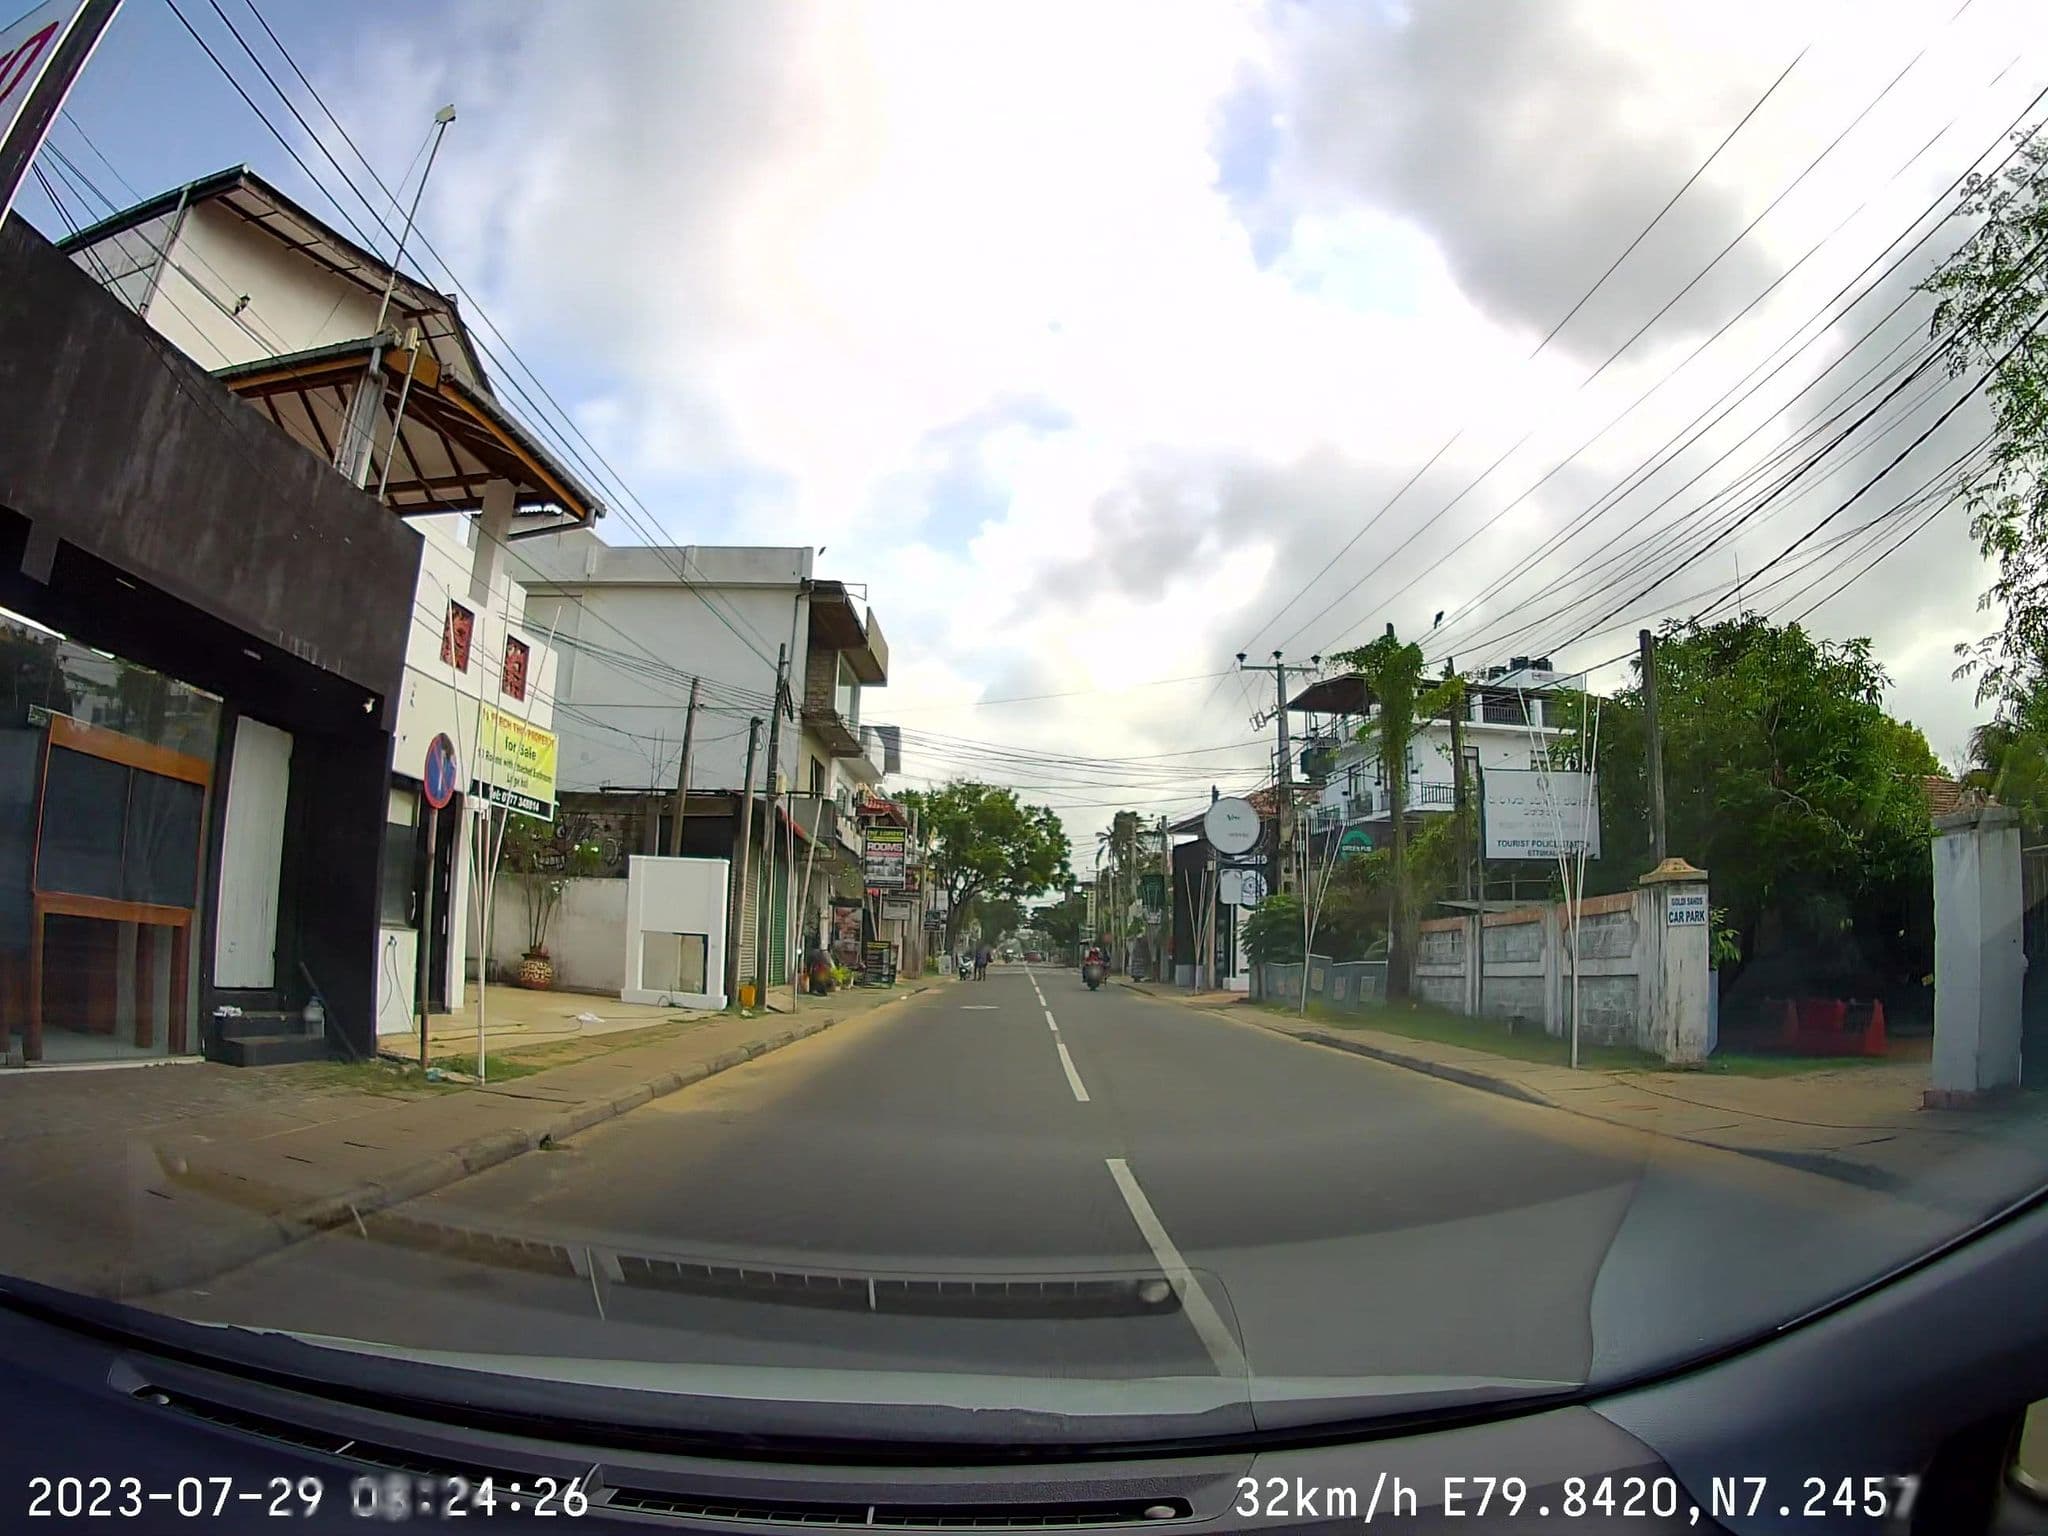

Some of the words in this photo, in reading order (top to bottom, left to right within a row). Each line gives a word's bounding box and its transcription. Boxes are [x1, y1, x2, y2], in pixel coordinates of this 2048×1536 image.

[505, 736, 517, 753] for
[867, 842, 903, 851] ROOMS
[1497, 839, 1529, 848] TOURIST
[1668, 911, 1685, 923] CAR
[1685, 910, 1705, 922] PARK
